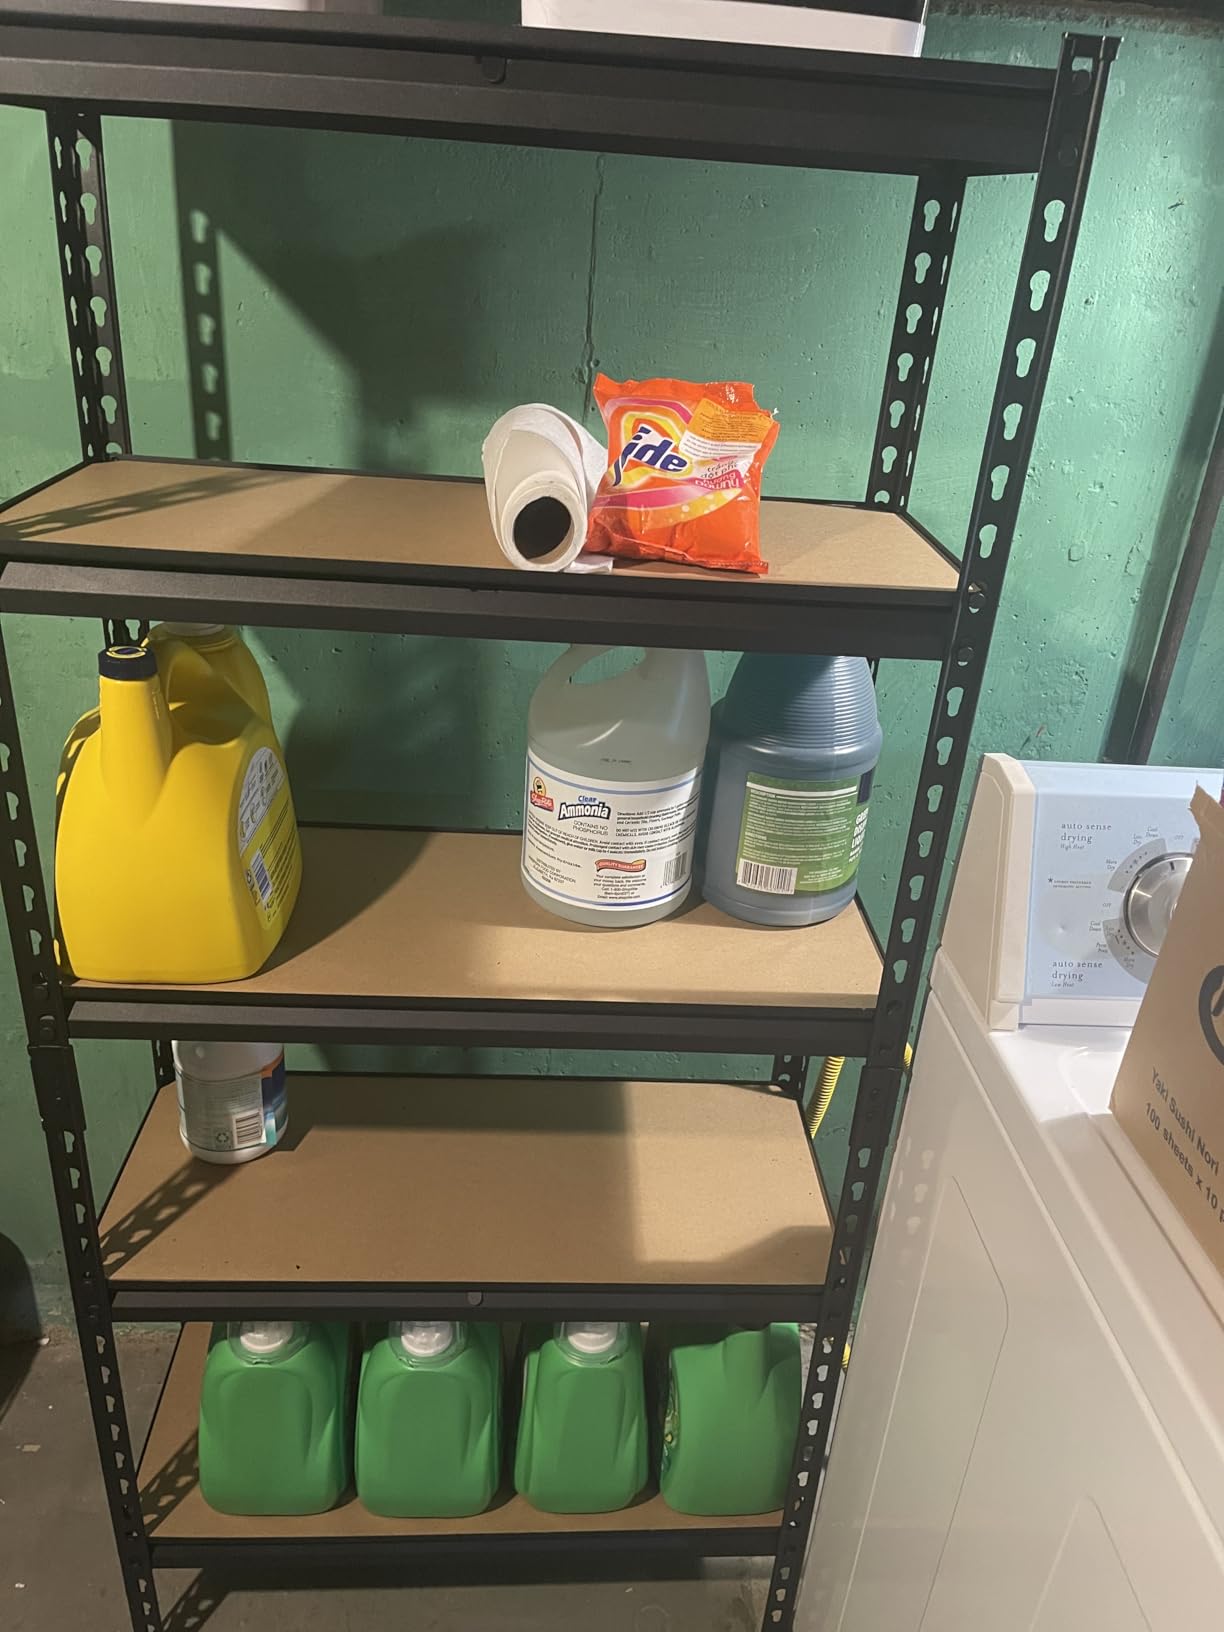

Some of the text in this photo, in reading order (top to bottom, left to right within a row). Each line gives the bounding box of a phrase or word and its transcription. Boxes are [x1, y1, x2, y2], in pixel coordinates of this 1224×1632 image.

[560, 803, 610, 819] Ammonia
[574, 820, 598, 830] CONTAINS
[1060, 832, 1092, 844] drying
[1052, 971, 1084, 981] drying
[1152, 1066, 1220, 1176] Yaki Sushi Nori
[1145, 1102, 1161, 1131] 100
[1163, 1128, 1194, 1177] sheets
[1196, 1175, 1204, 1191] x
[1206, 1186, 1218, 1209] 10
